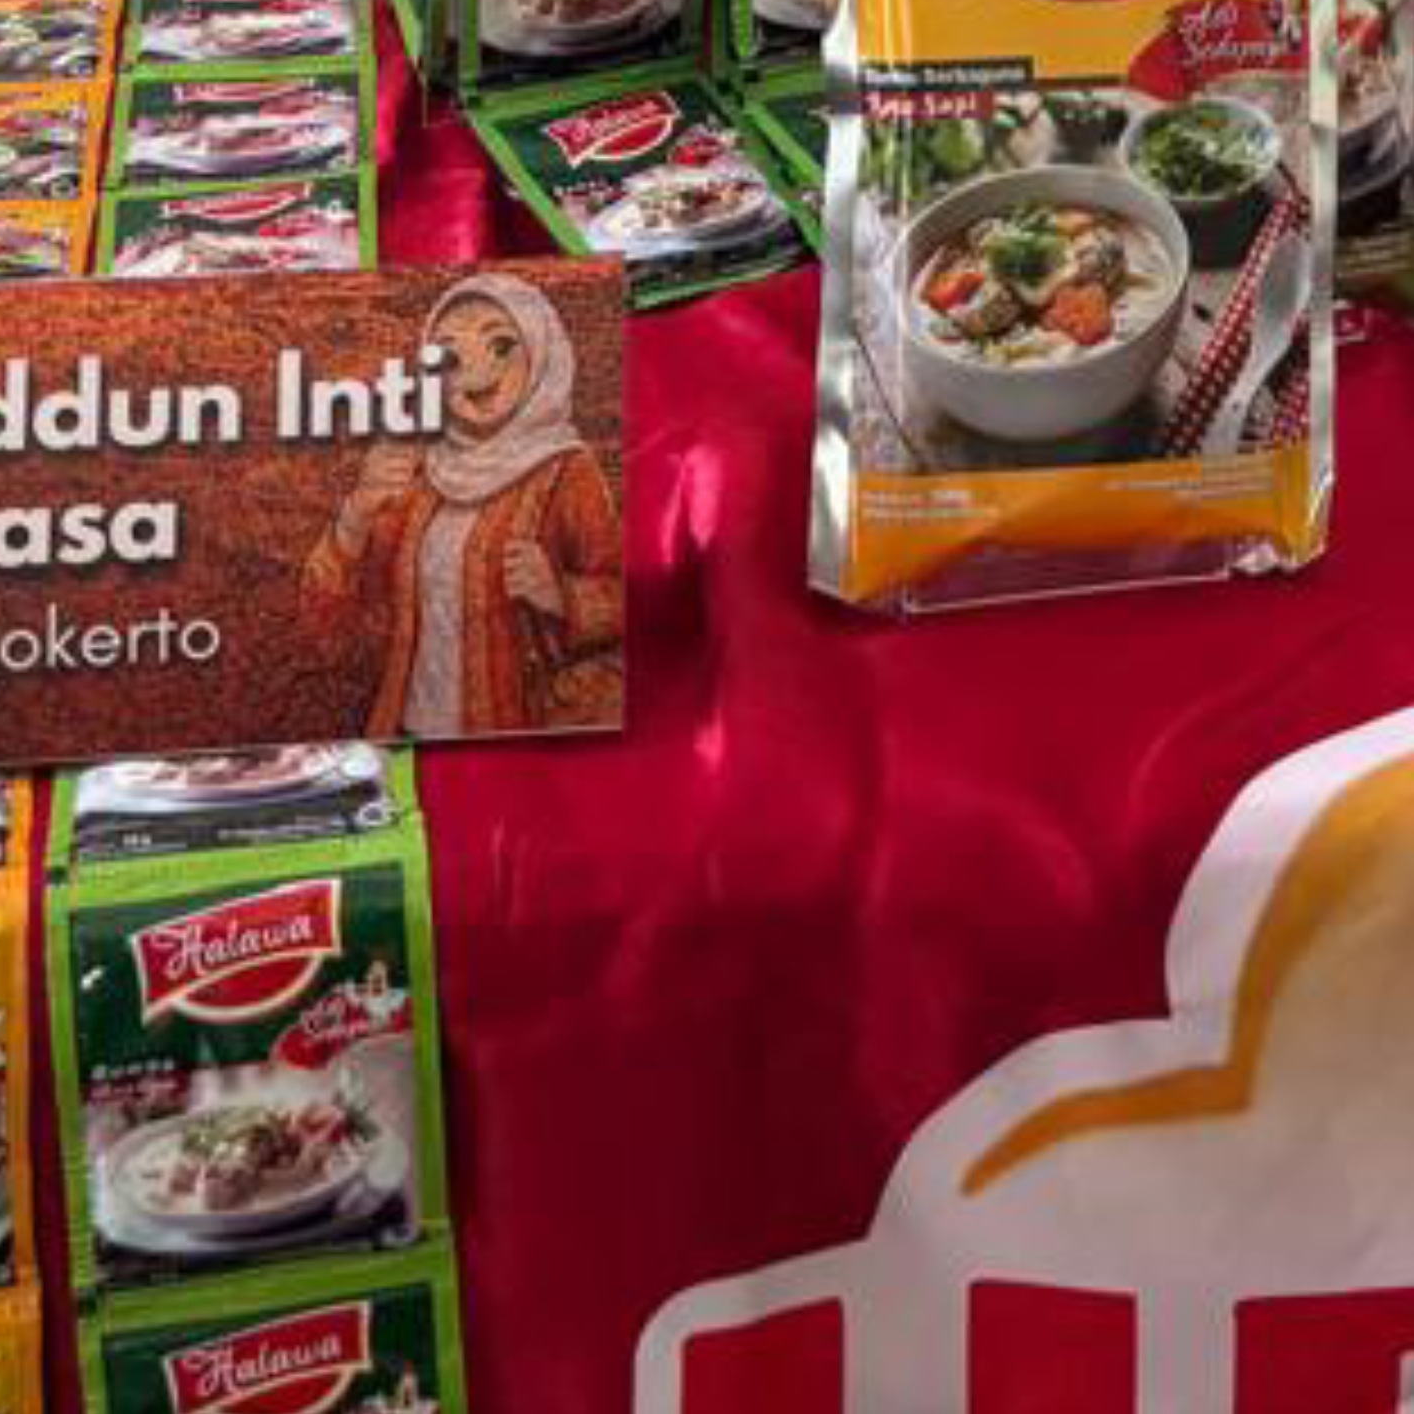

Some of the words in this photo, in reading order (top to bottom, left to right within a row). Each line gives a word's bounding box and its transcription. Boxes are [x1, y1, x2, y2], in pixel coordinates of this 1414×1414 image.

[275, 343, 448, 442] Inti
[149, 914, 314, 980] Halawa
[183, 1337, 343, 1397] Halawa
